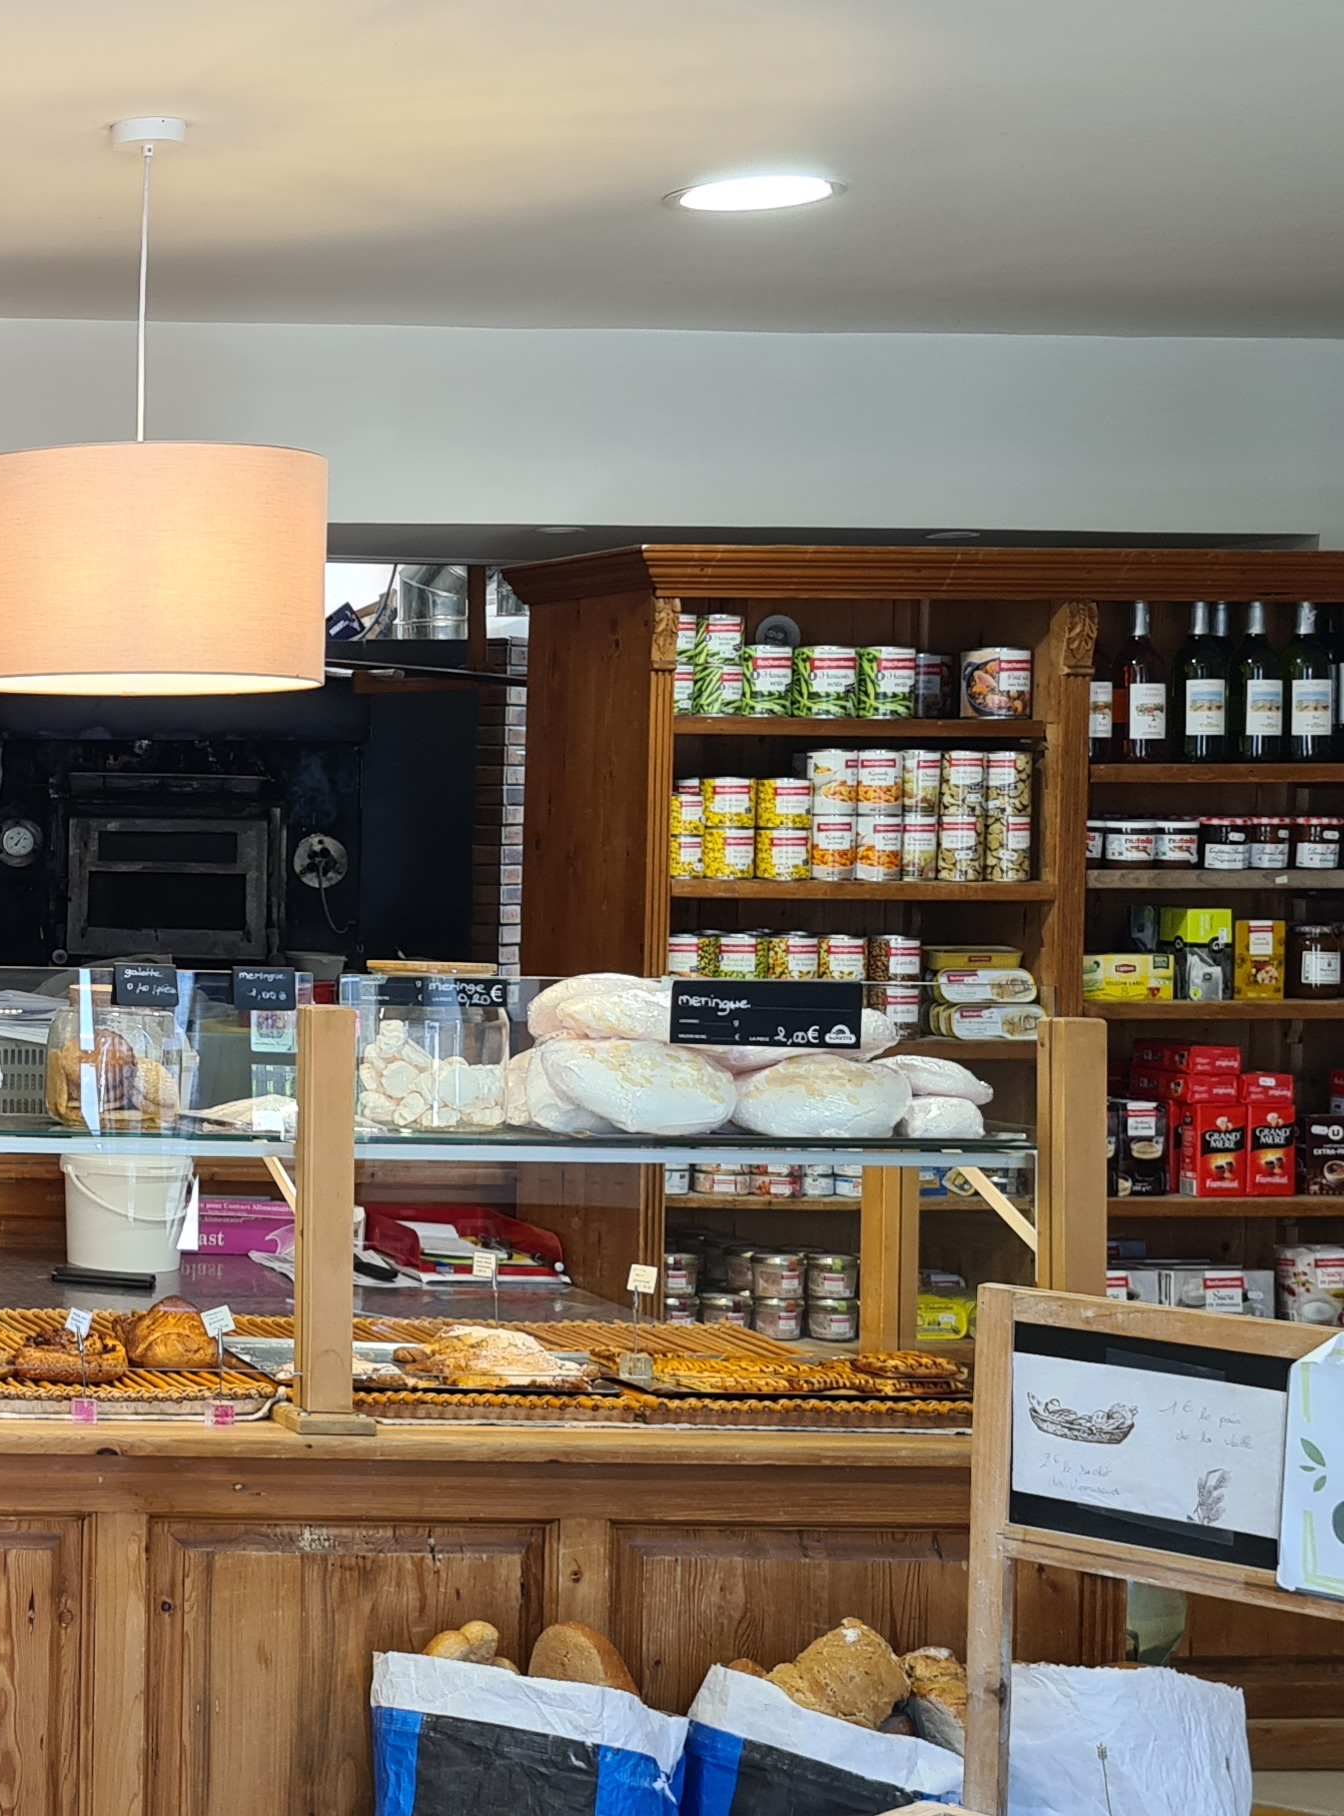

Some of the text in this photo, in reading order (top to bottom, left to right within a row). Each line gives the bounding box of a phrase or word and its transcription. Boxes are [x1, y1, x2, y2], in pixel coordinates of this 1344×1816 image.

[1124, 836, 1154, 845] nutella
[1167, 837, 1196, 845] nutella
[238, 971, 286, 982] meringue
[490, 984, 504, 1002] €
[678, 993, 751, 1015] meringue
[807, 1025, 820, 1043] €
[1206, 1179, 1239, 1189] Familial
[1255, 1174, 1288, 1184] Familial
[223, 1202, 251, 1211] Contact
